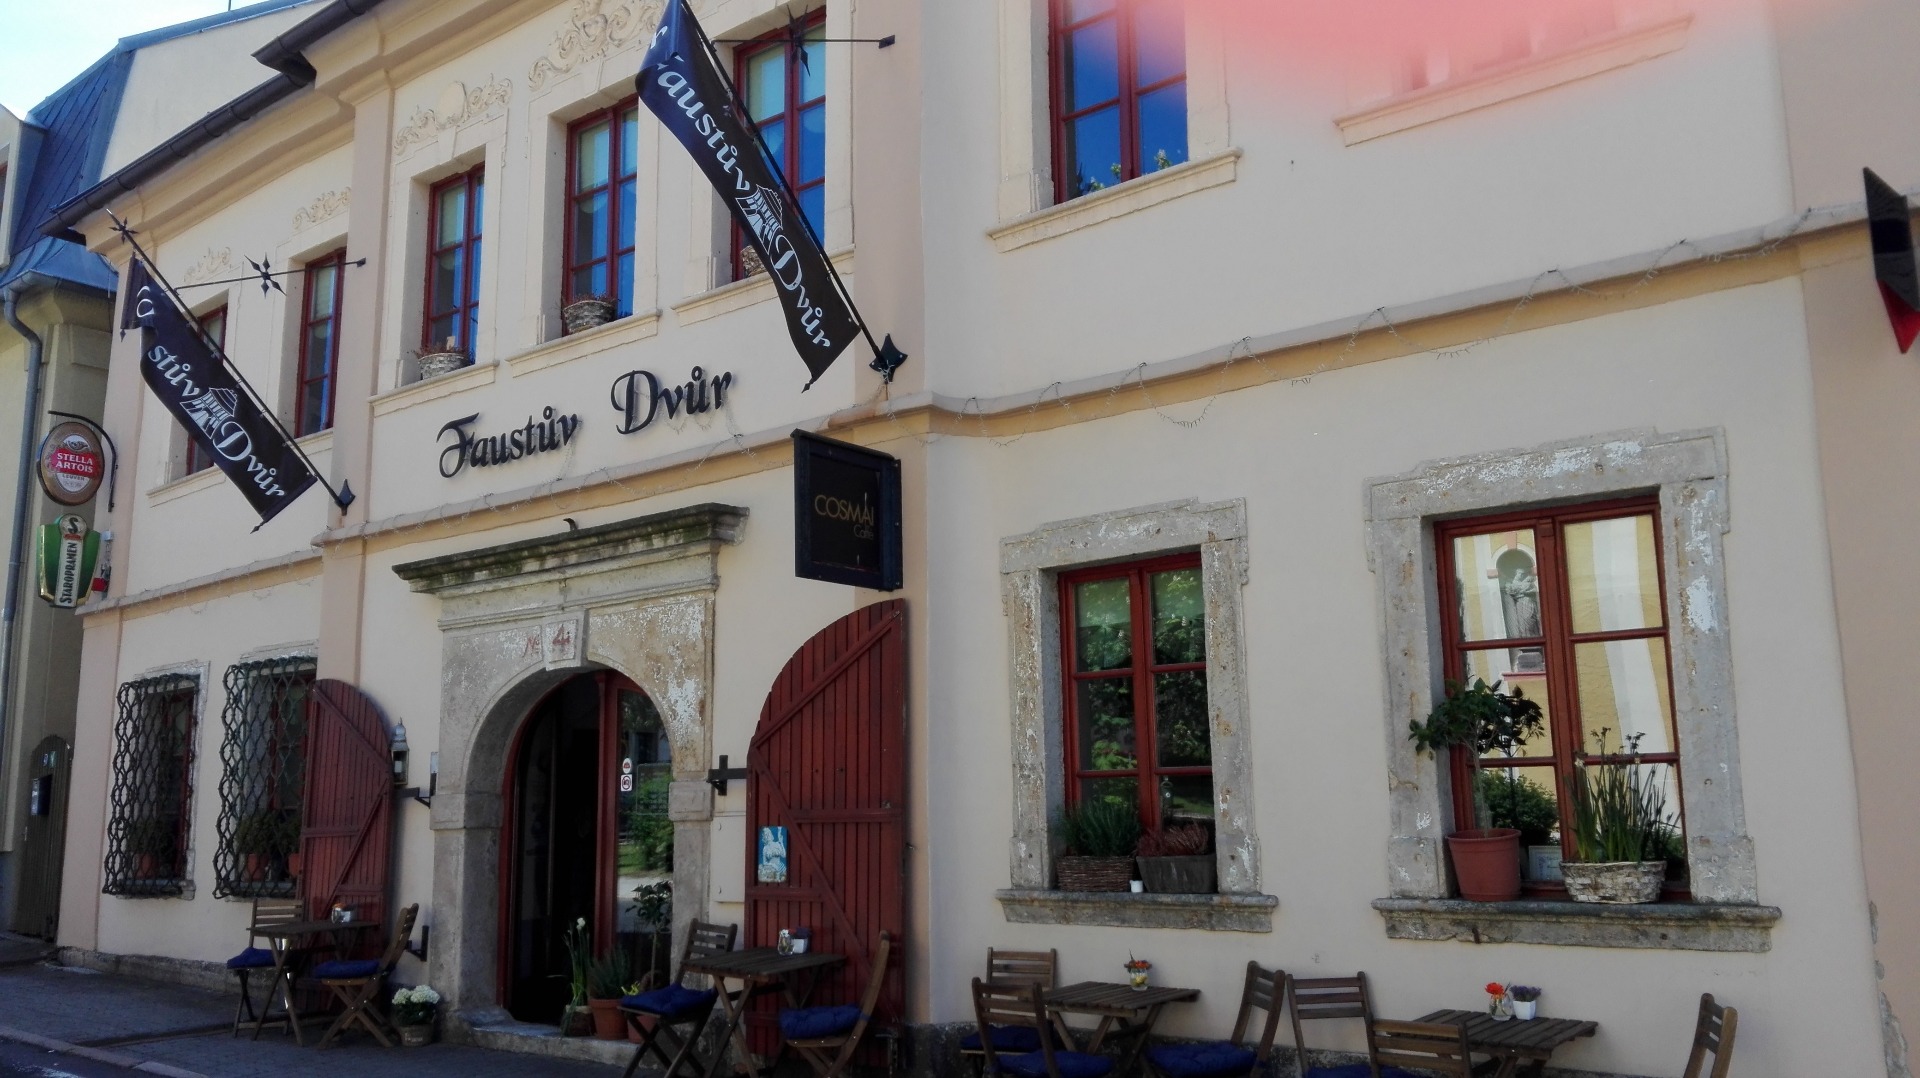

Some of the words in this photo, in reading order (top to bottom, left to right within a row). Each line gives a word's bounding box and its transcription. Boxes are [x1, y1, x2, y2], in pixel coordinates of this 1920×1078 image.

[657, 52, 750, 191] austův
[770, 234, 831, 348] Dvůr
[436, 405, 578, 478] Faustův
[610, 365, 732, 435] Dvůr
[55, 460, 93, 473] ARTOIS
[56, 452, 93, 465] STELLA
[212, 420, 285, 496] Dvůr
[59, 542, 78, 604] STAROPRAMEN
